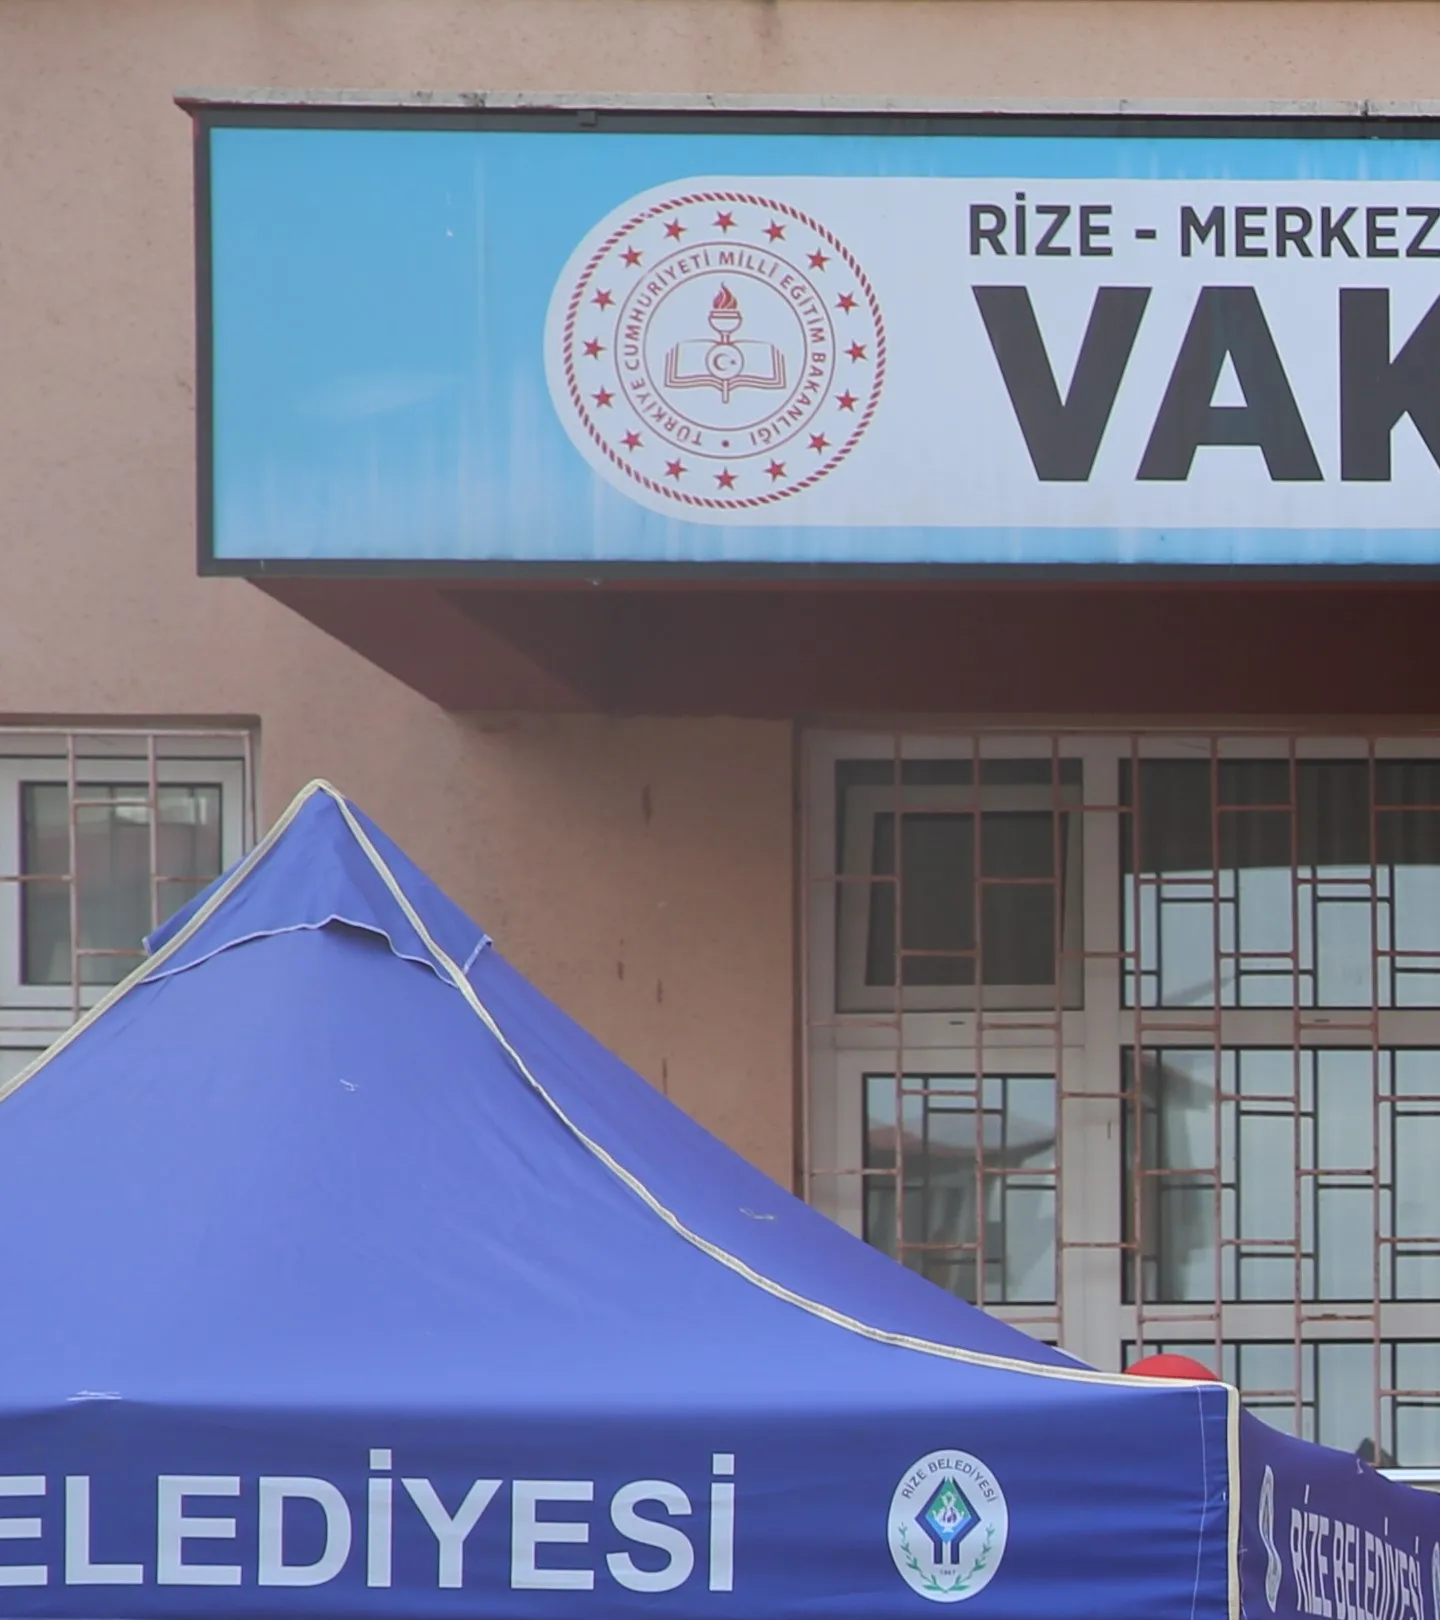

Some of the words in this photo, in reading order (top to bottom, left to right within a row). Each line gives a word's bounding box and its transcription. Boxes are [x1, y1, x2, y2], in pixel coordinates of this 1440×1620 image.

[968, 190, 1113, 259] RİZE
[1134, 230, 1157, 241] -
[718, 249, 779, 279] MİLLİ
[624, 249, 711, 371] CUMHURİYETİ
[779, 274, 826, 344] EĞİTİM
[631, 377, 703, 447] TÜRKİYE
[749, 351, 827, 447] BAKANLIĞI
[901, 1468, 928, 1500] RİZE
[927, 1457, 999, 1503] BELEDİYESİ
[0, 1448, 736, 1594] ELEDİYESİ
[1290, 1484, 1333, 1619] RİZE
